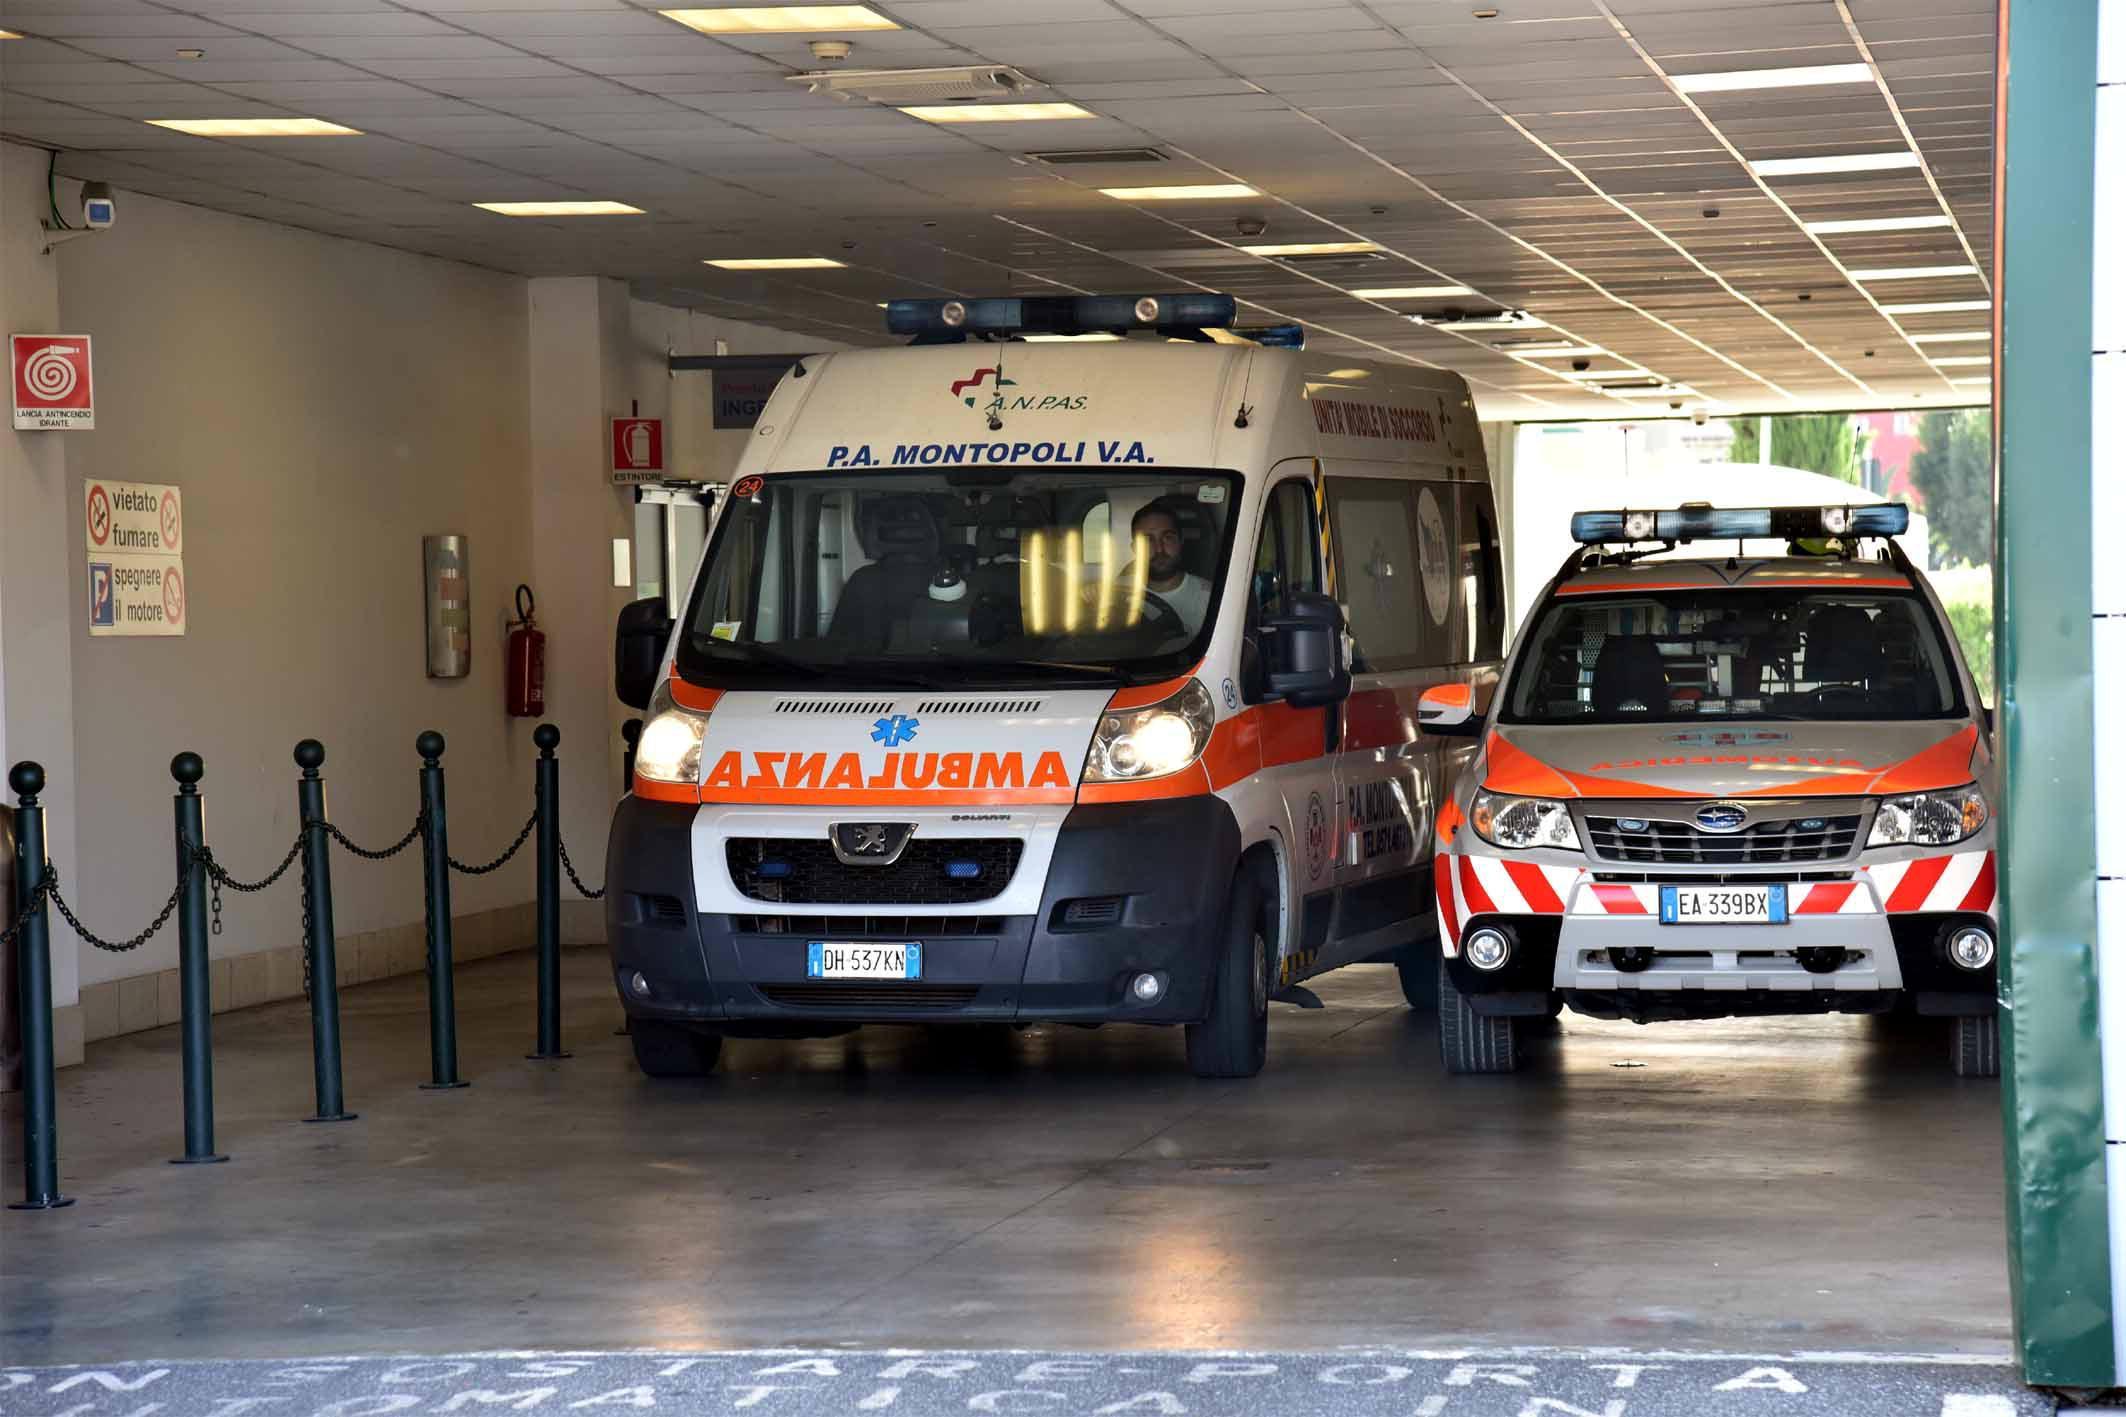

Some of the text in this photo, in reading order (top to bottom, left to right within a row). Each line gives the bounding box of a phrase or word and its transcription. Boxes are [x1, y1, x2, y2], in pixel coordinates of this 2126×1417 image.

[16, 410, 91, 418] LANCIA ANTINCENDIO
[39, 419, 70, 427] IDRANTE
[1388, 406, 1435, 441] SOCCORSO
[827, 441, 1155, 467] P.A. MONTOPOLI V.A.
[614, 472, 663, 481] ESTINTORE
[739, 481, 759, 494] 24
[112, 487, 158, 512] vietato
[112, 523, 160, 548] fumare
[114, 565, 161, 592] spegnere
[114, 600, 163, 622] il motore
[1225, 684, 1236, 702] 24
[1679, 892, 1702, 915] EA
[1707, 892, 1767, 915] 339BX
[823, 949, 845, 972] DH
[849, 949, 905, 972] 537KN
